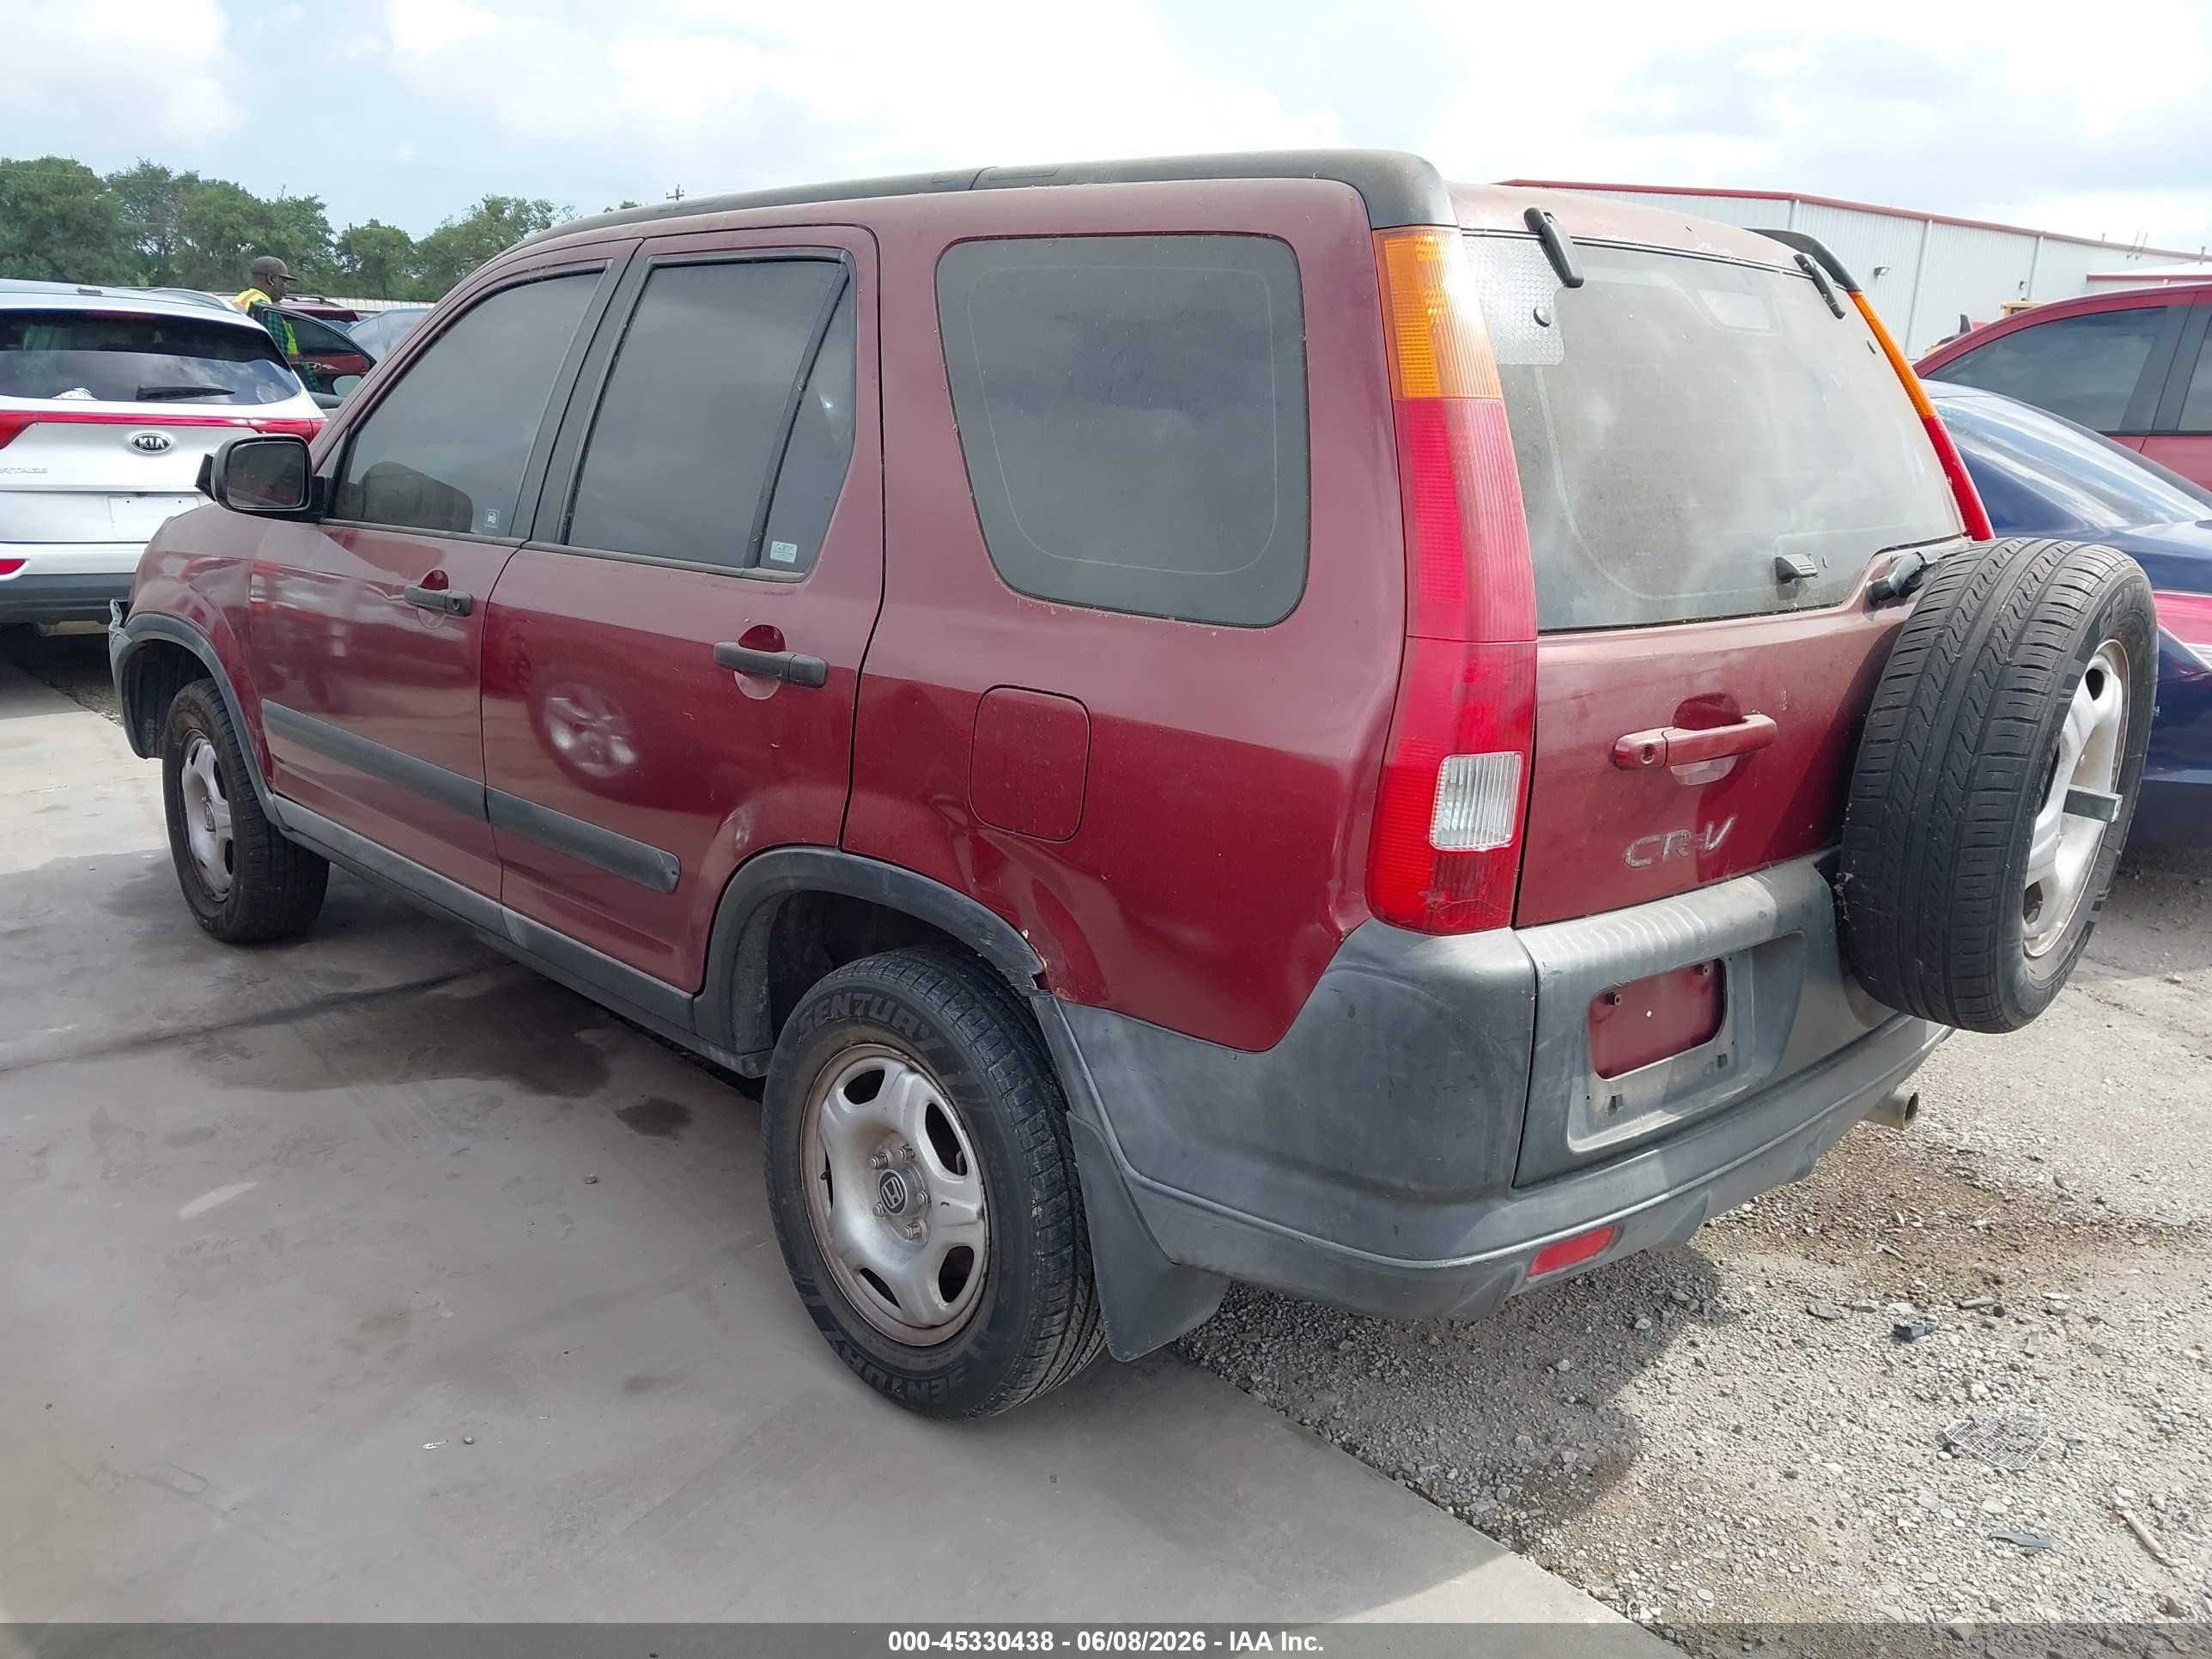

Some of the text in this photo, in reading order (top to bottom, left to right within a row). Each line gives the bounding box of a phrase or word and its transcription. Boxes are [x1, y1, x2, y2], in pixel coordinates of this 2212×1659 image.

[137, 436, 165, 449] KIA
[1624, 814, 1737, 869] CR-V
[798, 991, 945, 1052] SENTURY
